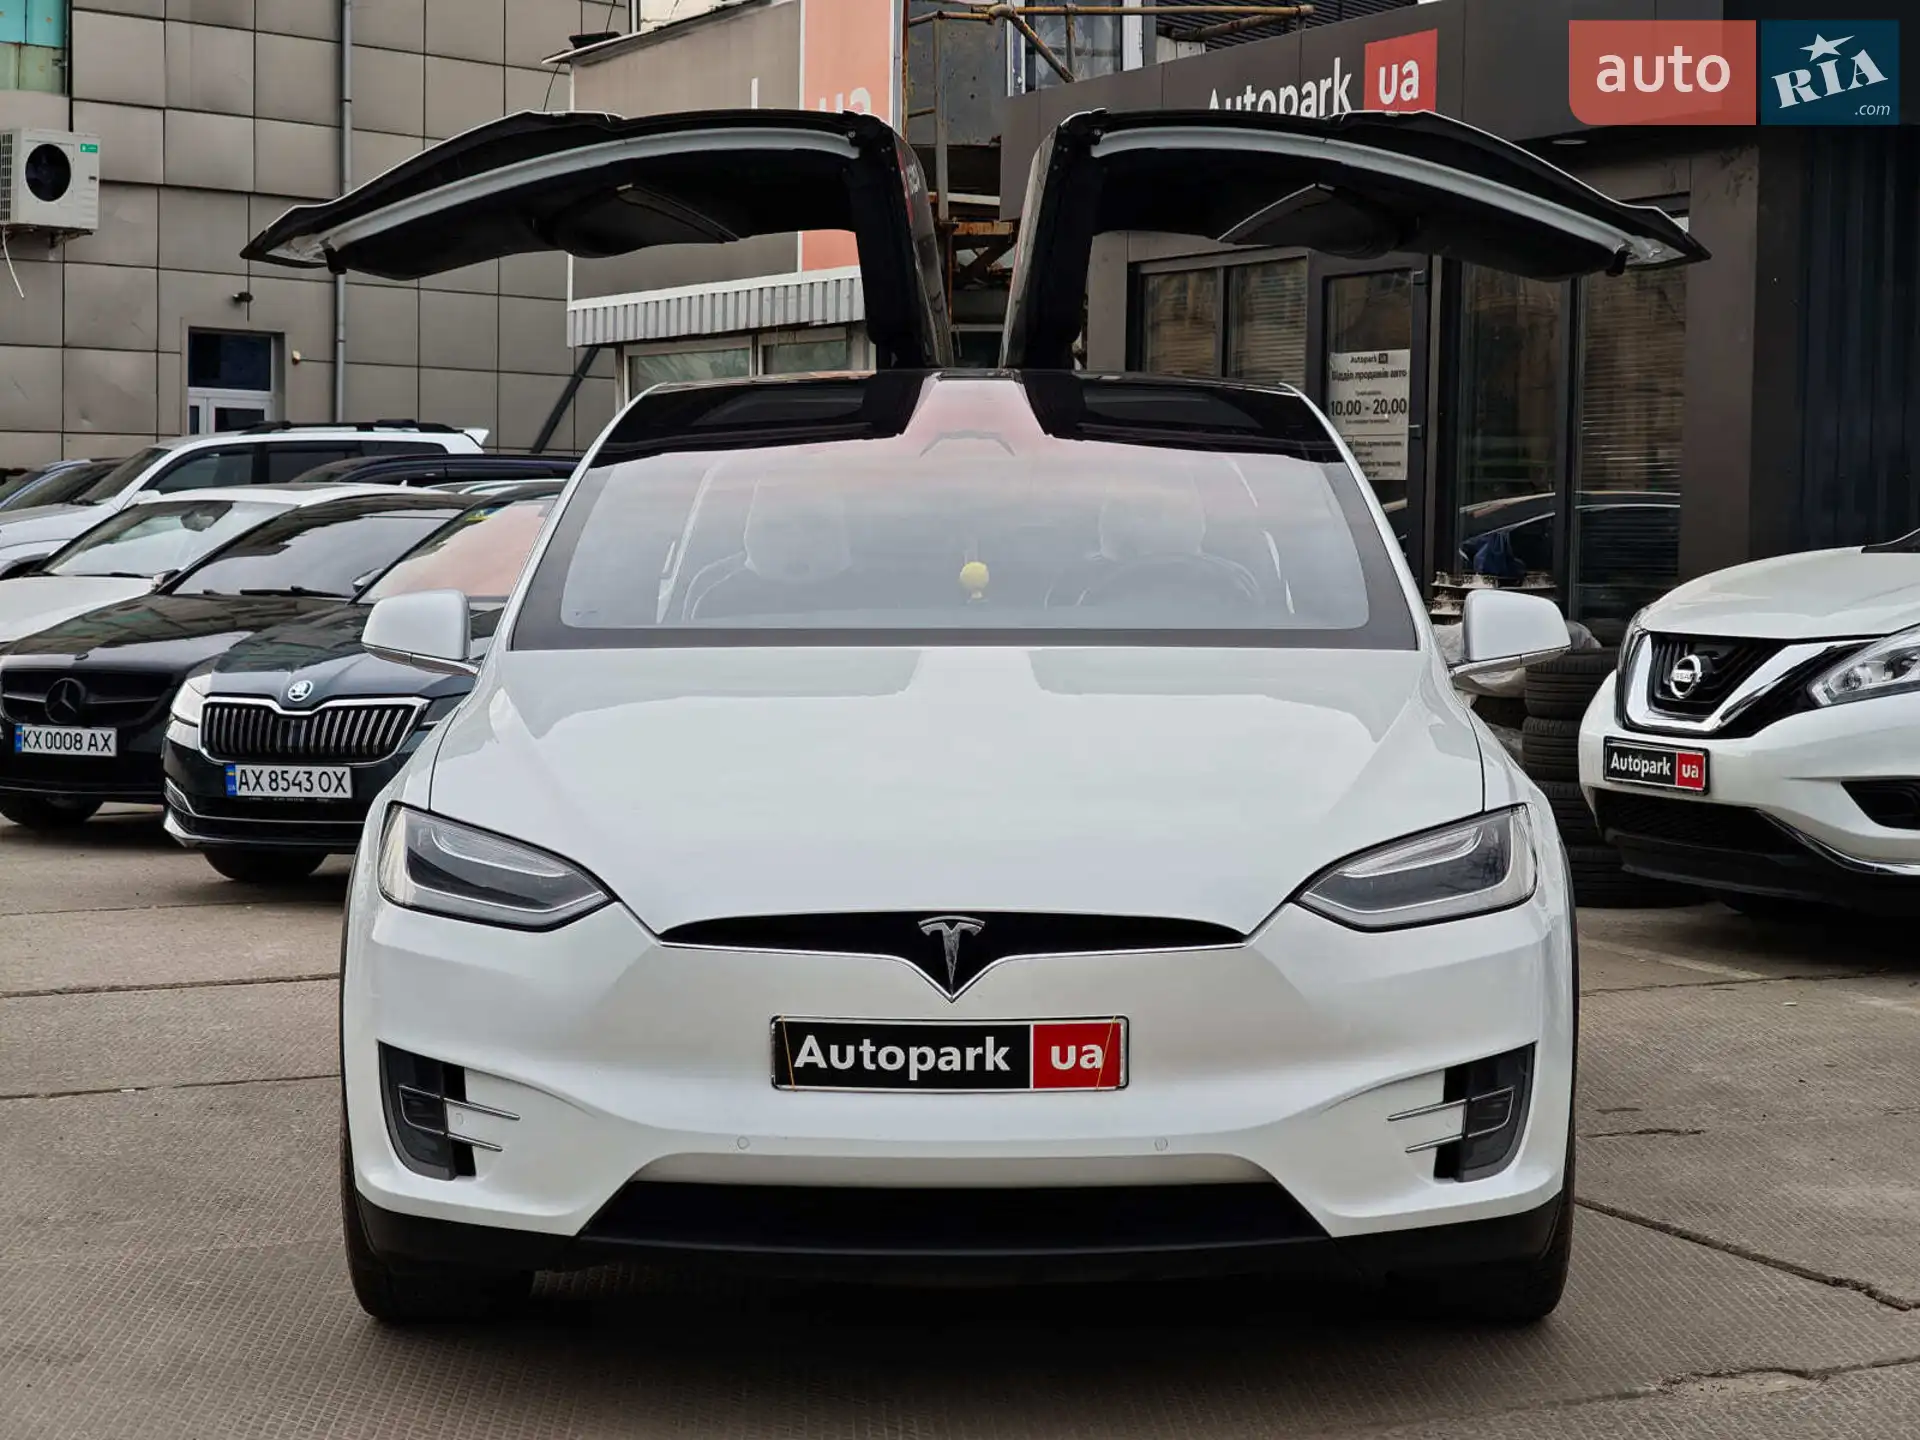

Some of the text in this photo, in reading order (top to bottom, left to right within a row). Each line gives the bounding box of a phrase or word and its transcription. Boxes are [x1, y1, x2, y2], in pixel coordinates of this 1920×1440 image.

[1209, 57, 1419, 118] opark ua
[1331, 400, 1361, 416] 10.00
[1373, 398, 1407, 415] 20.00
[23, 729, 112, 752] KX 0008 AX
[1610, 752, 1699, 778] Autopark ua
[238, 769, 347, 793] AX 8543 OX
[794, 1034, 1104, 1081] Autopark ua
